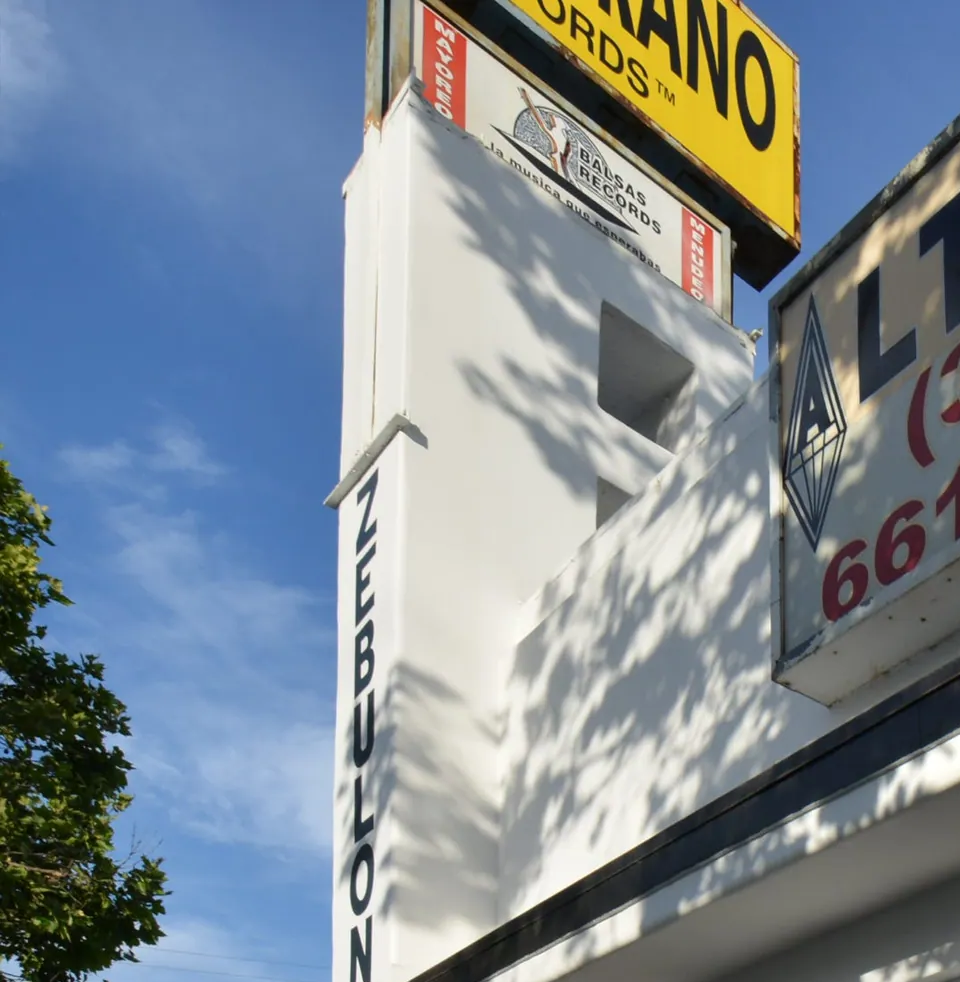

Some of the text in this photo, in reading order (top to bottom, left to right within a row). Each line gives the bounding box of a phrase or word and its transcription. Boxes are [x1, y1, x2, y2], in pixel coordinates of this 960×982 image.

[434, 19, 455, 120] MAYOREO
[598, 0, 776, 152] ANO
[579, 166, 662, 235] RECORDS
[580, 148, 647, 207] BALSAS
